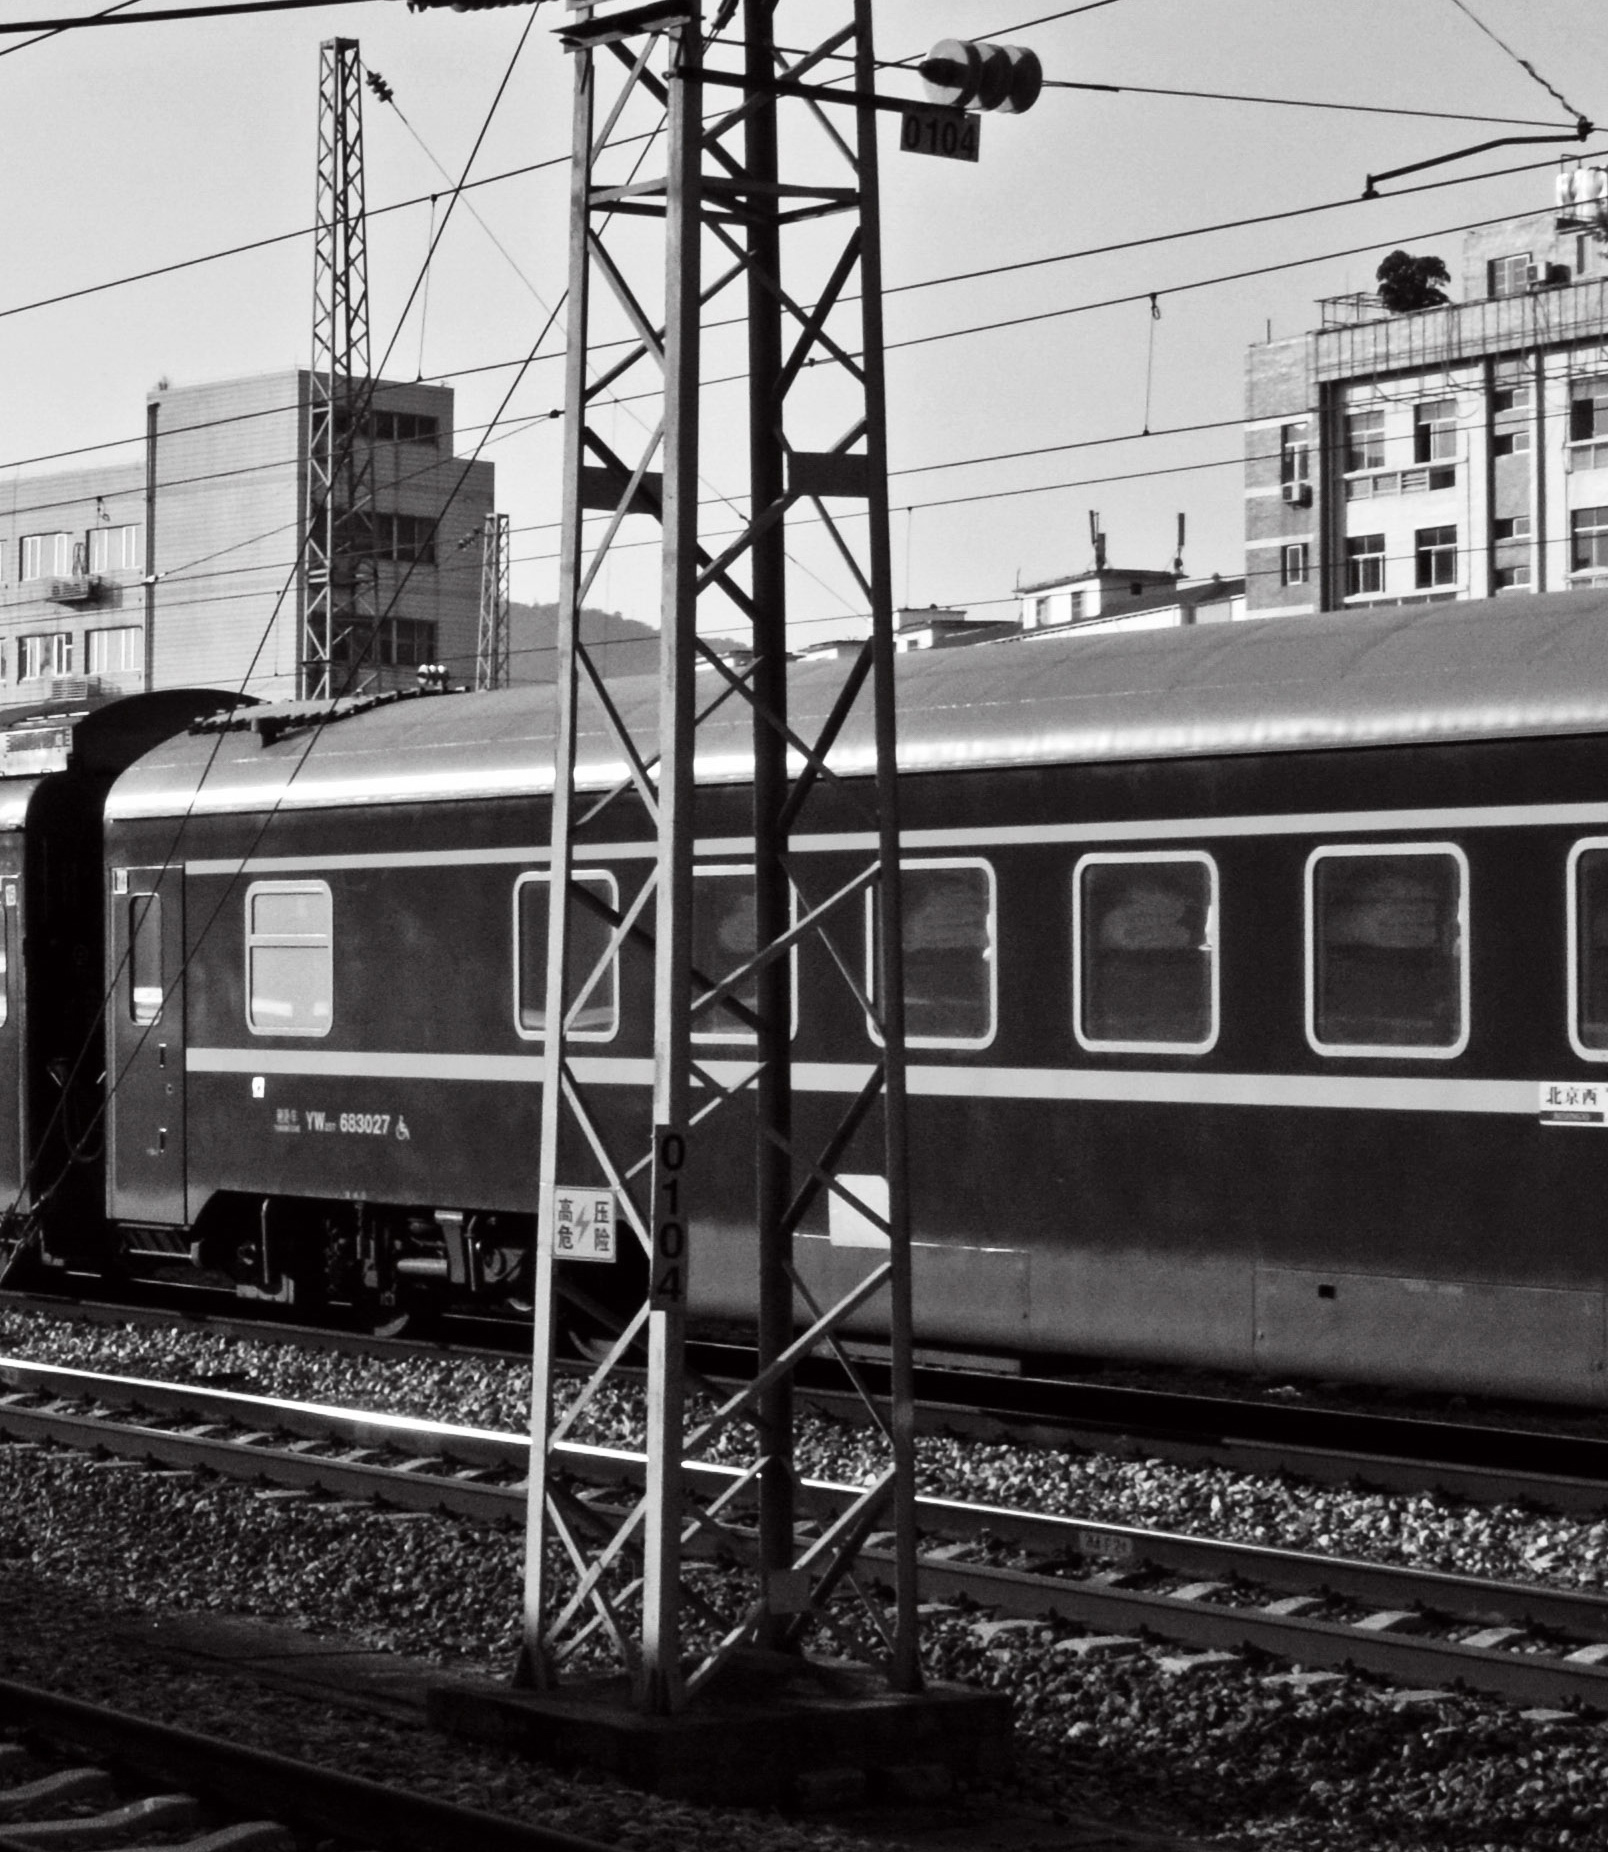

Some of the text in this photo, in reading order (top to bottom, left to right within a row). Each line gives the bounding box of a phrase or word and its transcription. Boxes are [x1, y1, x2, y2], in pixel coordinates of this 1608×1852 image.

[903, 115, 976, 159] 0104
[1545, 1086, 1598, 1105] 北京西
[340, 1112, 391, 1135] 683027
[657, 1133, 686, 1302] 0104
